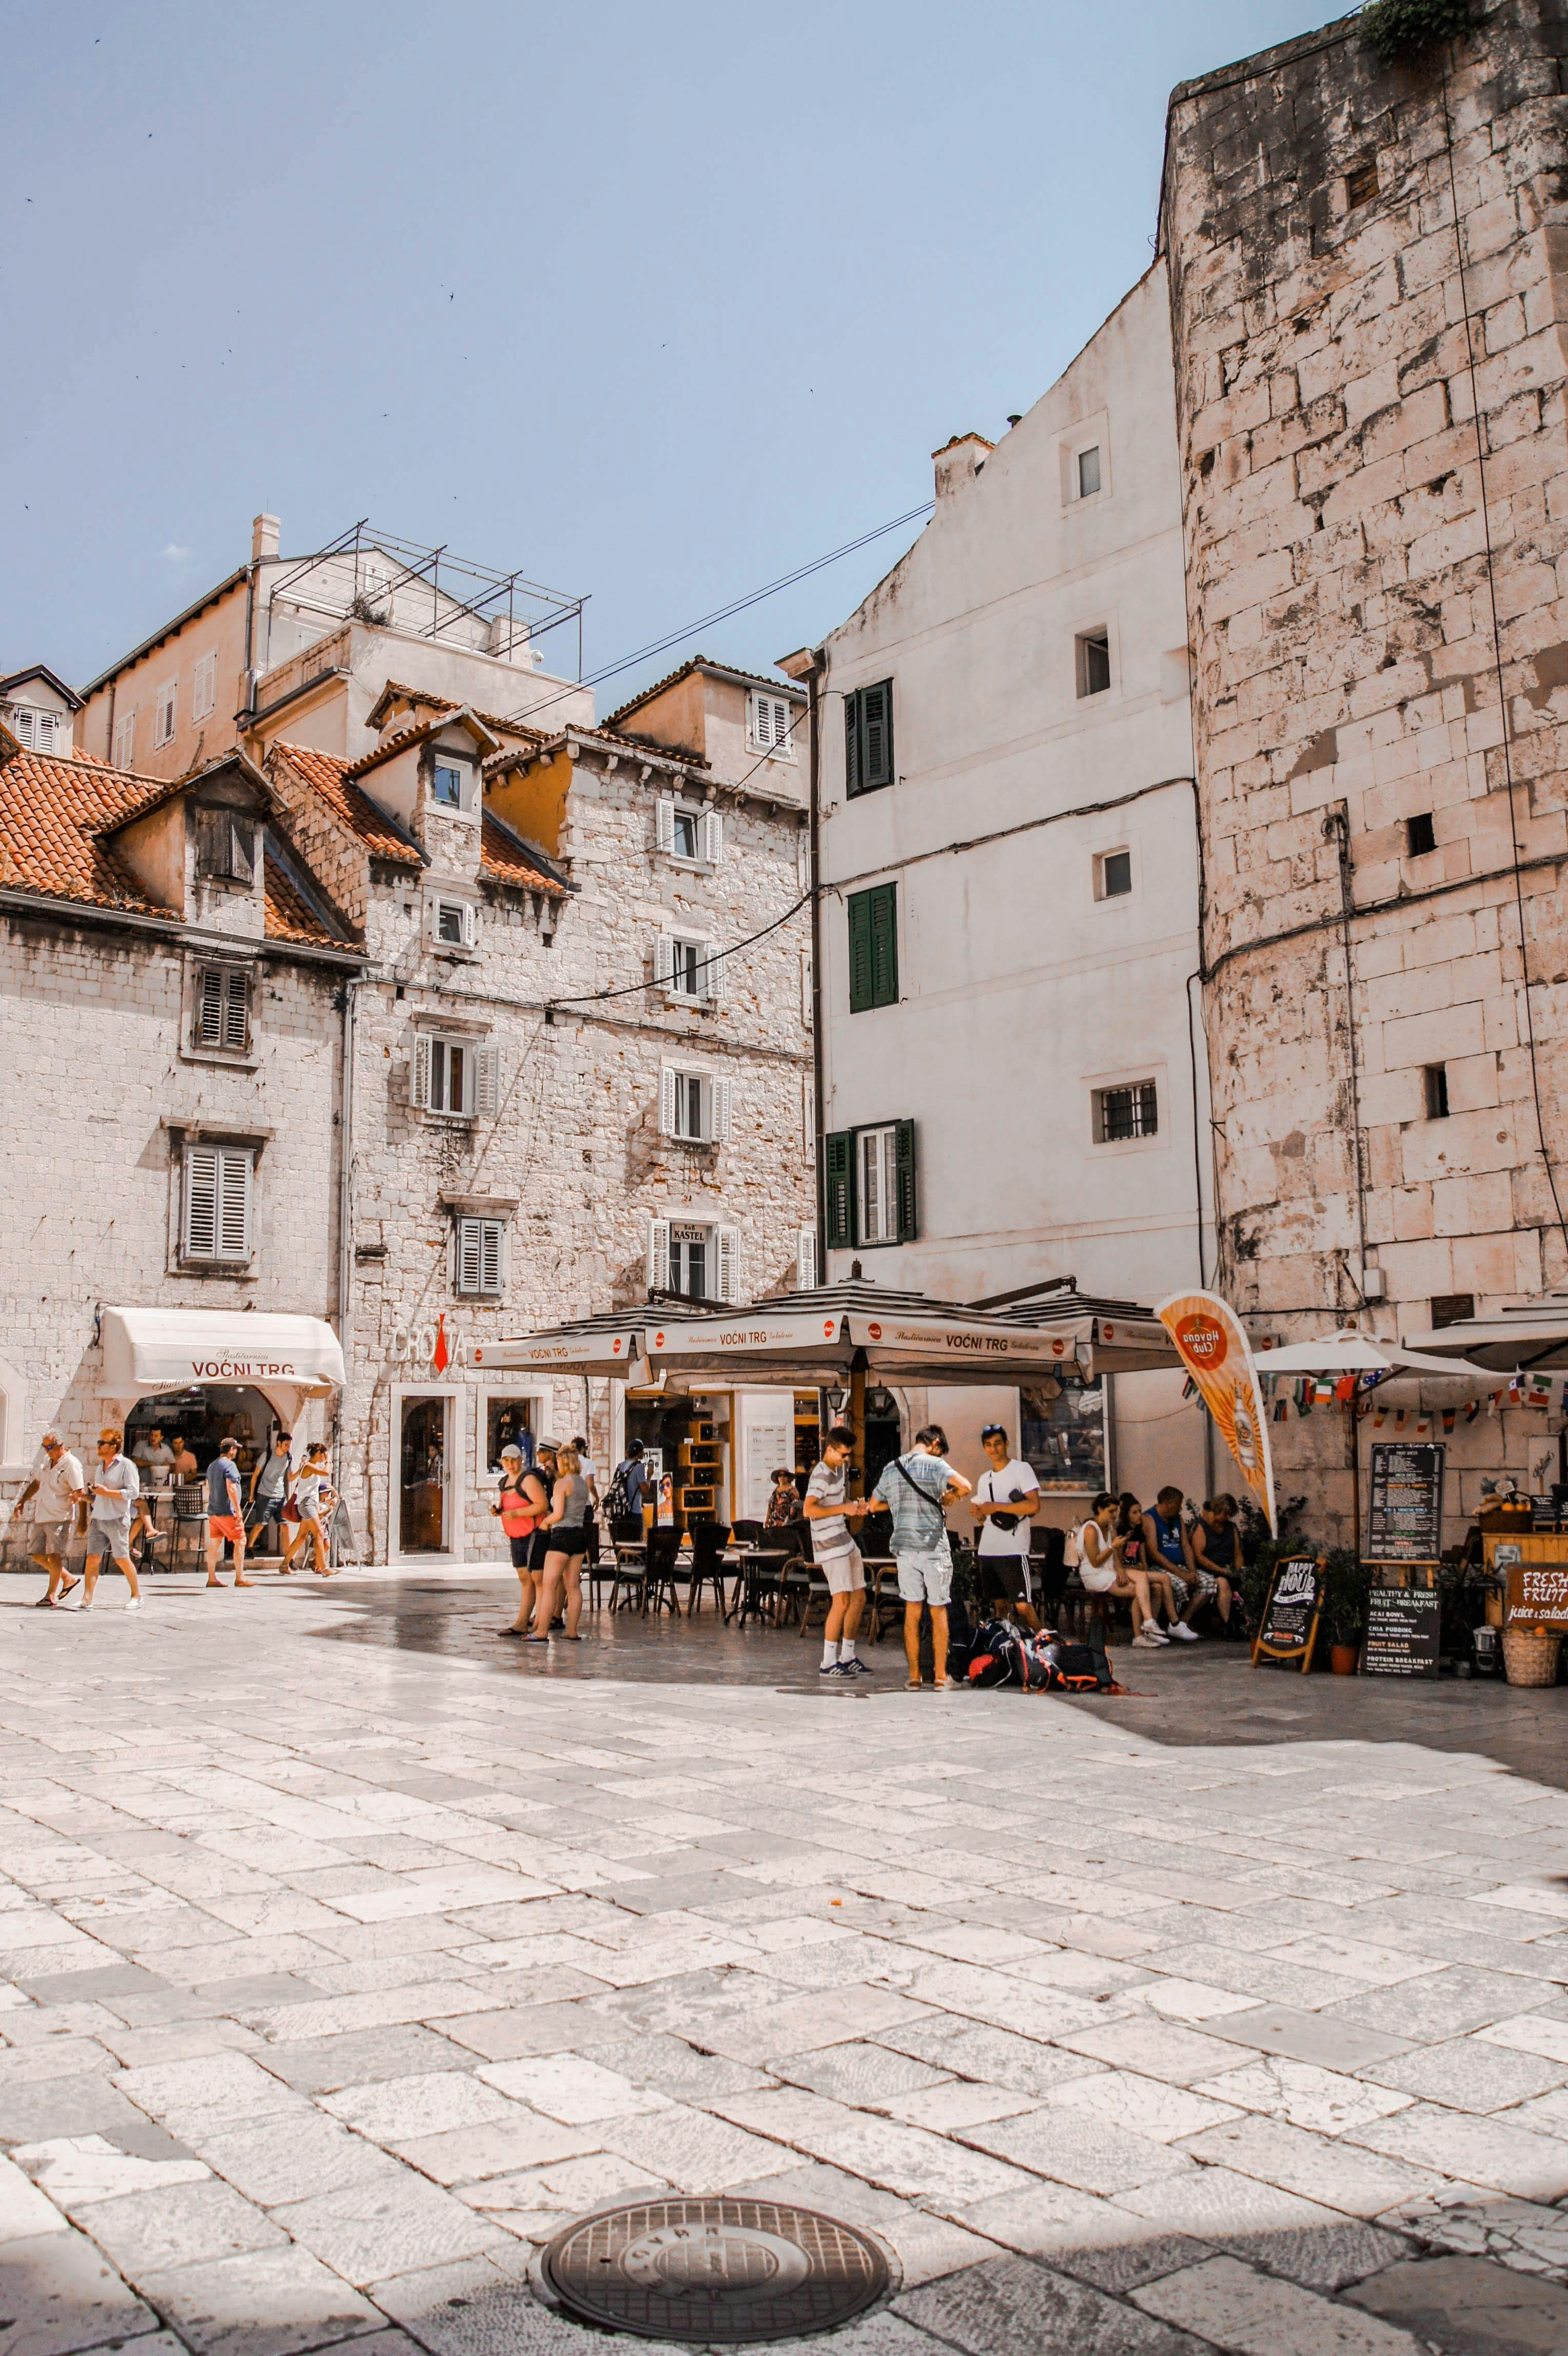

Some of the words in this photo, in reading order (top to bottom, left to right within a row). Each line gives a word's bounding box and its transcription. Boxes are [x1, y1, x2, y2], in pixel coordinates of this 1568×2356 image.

[720, 1330, 747, 1345] VOĆNI
[749, 1331, 767, 1343] TRG
[946, 1333, 982, 1349] VOĆNI
[986, 1337, 1008, 1351] TRG
[552, 1347, 568, 1358] TRG
[191, 1359, 250, 1377] VOĆNI
[256, 1363, 295, 1375] TRG
[1287, 1562, 1315, 1575] HAPPY
[1278, 1573, 1316, 1593] HOUR
[1523, 1572, 1568, 1587] FRESH
[1413, 1591, 1437, 1599] FRESH
[1523, 1587, 1568, 1602] FRUIT
[1370, 1598, 1391, 1607] FRUIT
[1395, 1599, 1439, 1611] BREAKFAST
[1507, 1605, 1534, 1621] juice
